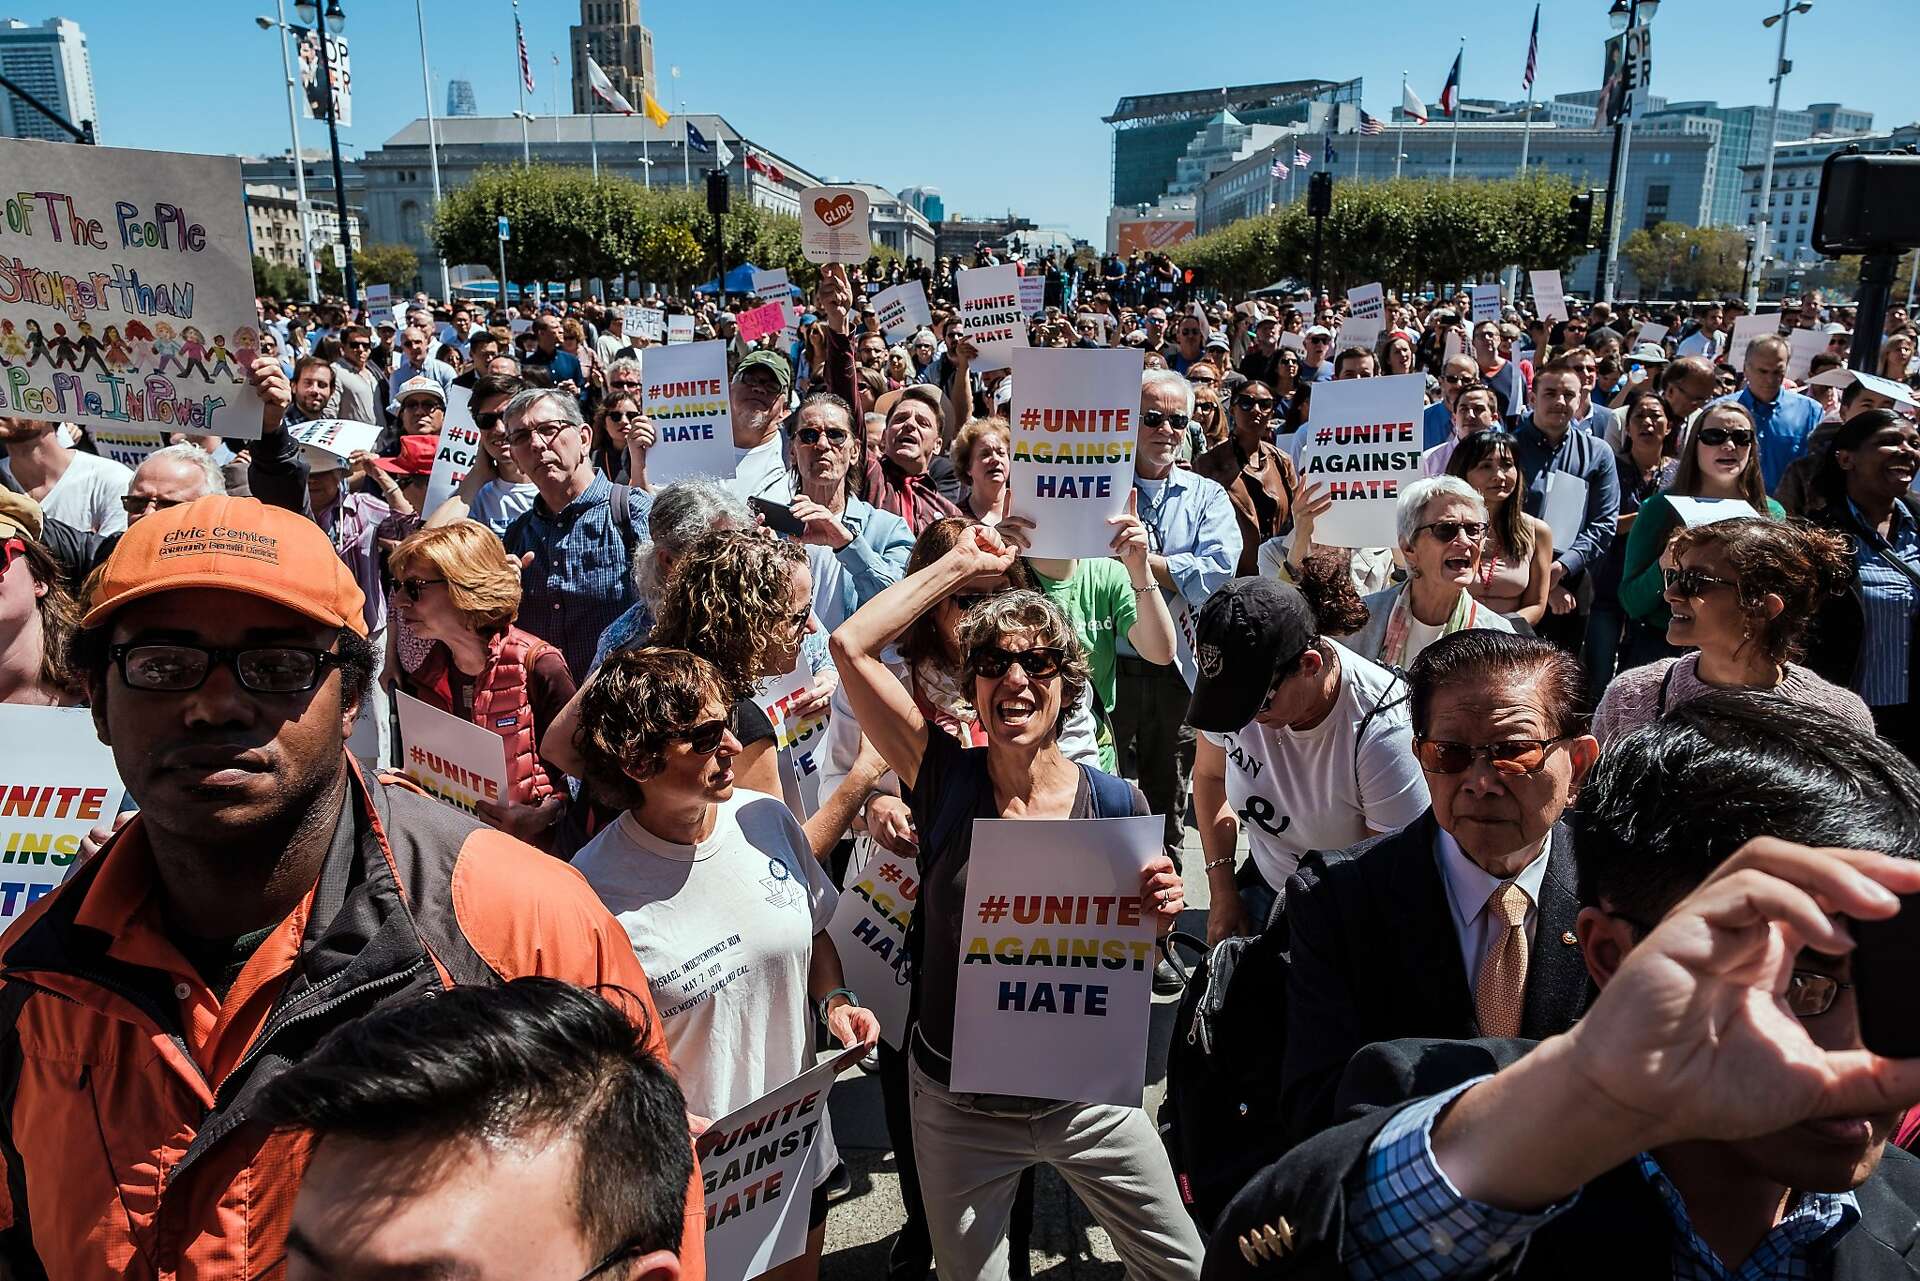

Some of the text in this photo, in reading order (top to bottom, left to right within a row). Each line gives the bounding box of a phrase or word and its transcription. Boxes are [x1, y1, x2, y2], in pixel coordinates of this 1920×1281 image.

[823, 201, 853, 224] GLIDE
[879, 306, 906, 323] AGAINST
[965, 295, 1016, 312] #UNITE
[625, 320, 660, 337] HATE
[886, 317, 904, 330] HATE
[964, 311, 1022, 329] AGAINST
[975, 329, 1014, 344] HATE
[648, 379, 721, 400] #UNITE
[645, 400, 729, 421] AGAINST
[1020, 408, 1131, 433] #UNITE
[96, 431, 161, 447] AGAINST
[662, 424, 714, 442] HATE
[1315, 422, 1414, 446] #UNITE
[1013, 441, 1136, 465] AGAINST
[1309, 451, 1422, 474] AGAINST
[1036, 475, 1112, 499] HATE
[1330, 480, 1398, 500] HATE
[163, 526, 278, 547] Civic Center
[410, 745, 499, 801] #UNITE
[978, 895, 1142, 927] #UNITE
[656, 934, 742, 990] ISRAEL INDEPENDENCE RUN
[964, 936, 1152, 972] AGAINST
[681, 977, 699, 994] MAY
[708, 962, 723, 978] 1978
[660, 1006, 679, 1020] LAKE
[677, 990, 709, 1014] MERRITT
[710, 971, 737, 995] OAKLAND
[997, 981, 1109, 1017] HATE
[712, 1090, 822, 1158] UNITE
[703, 1120, 820, 1196] GAINST
